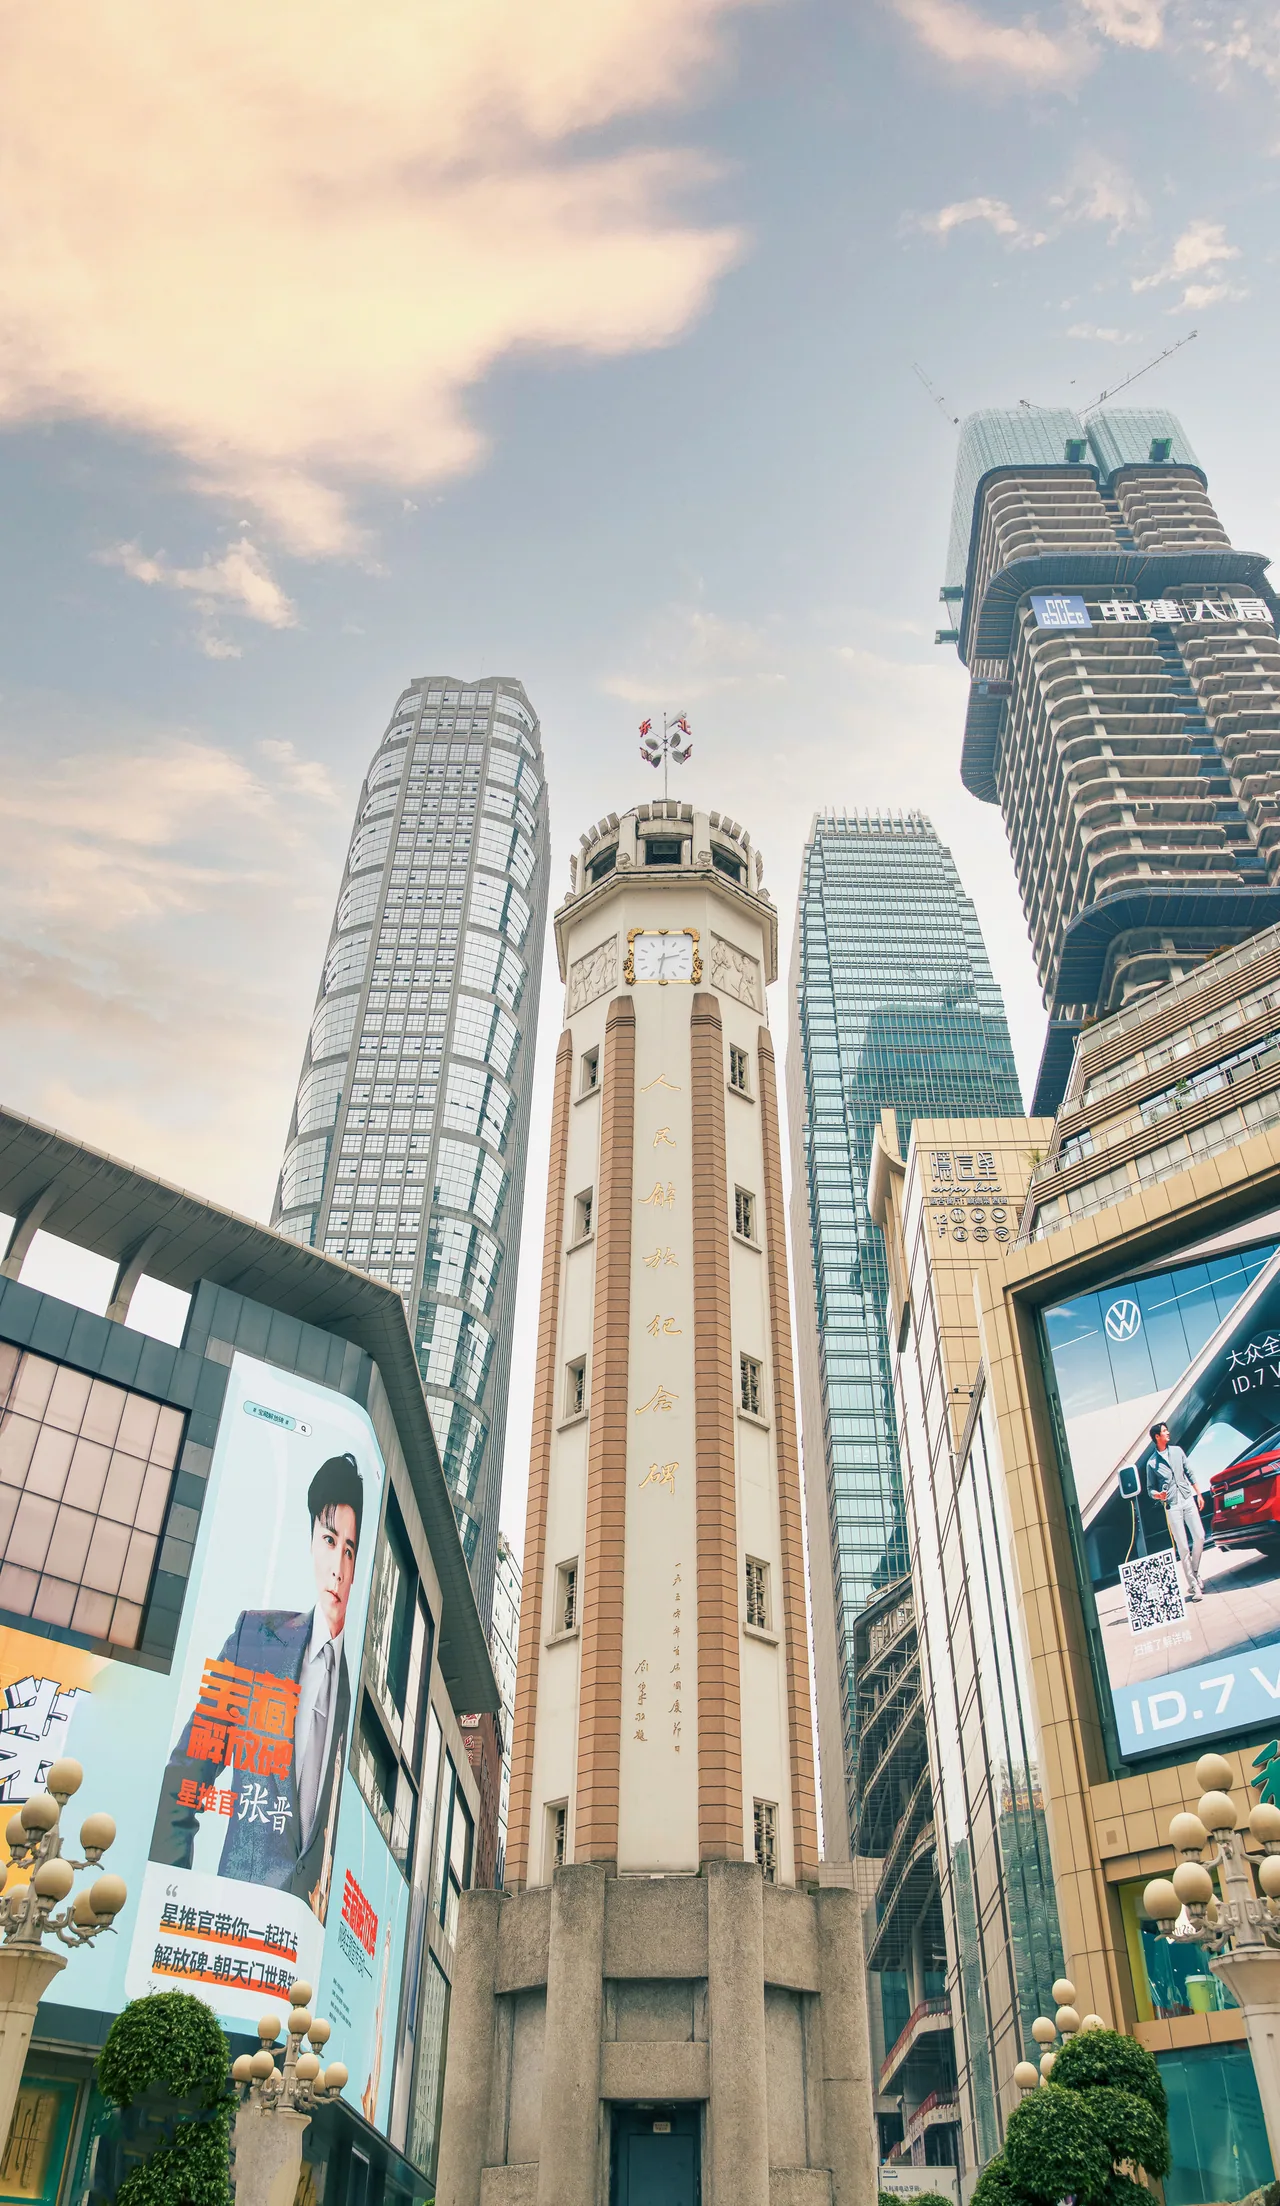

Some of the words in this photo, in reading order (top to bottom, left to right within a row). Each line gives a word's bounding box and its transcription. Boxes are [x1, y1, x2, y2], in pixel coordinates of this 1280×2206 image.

[1100, 599, 1274, 623] 中建八局
[933, 1214, 948, 1225] 12
[1232, 1368, 1264, 1395] ID.7
[1134, 1630, 1192, 1656] 扫描了解详情
[195, 1658, 302, 1739] 宝藏
[1131, 1674, 1235, 1735] ID.7
[186, 1715, 294, 1781] 解放碑
[176, 1778, 238, 1818] 星推官
[238, 1783, 292, 1834] 张晋
[159, 1902, 298, 1956] 星推官带你一起打卡
[152, 1943, 298, 1994] 解放碑-朝天门世界知
